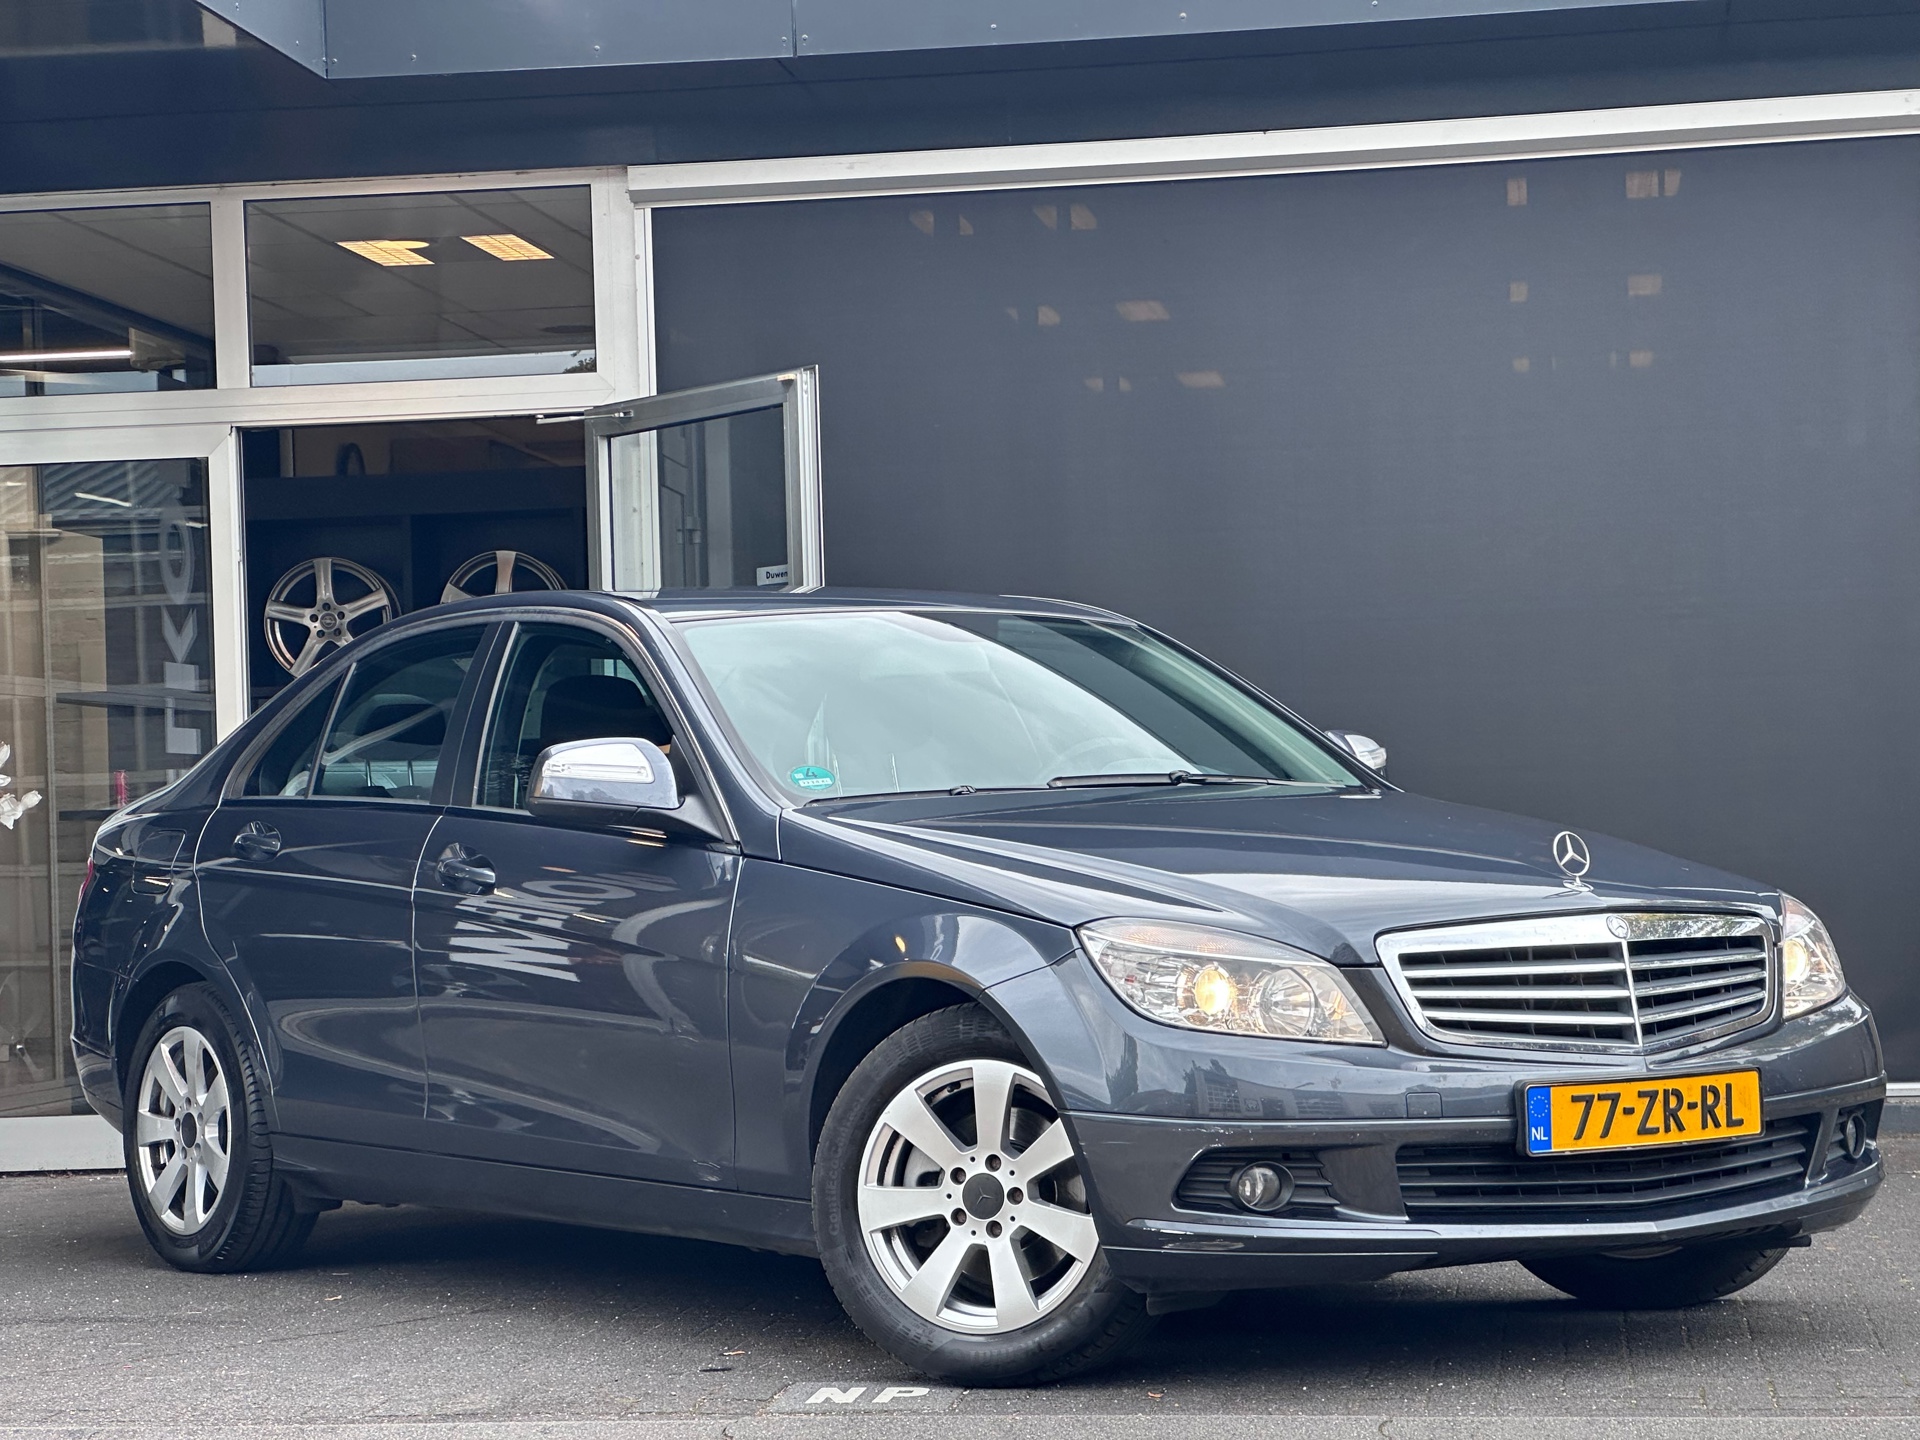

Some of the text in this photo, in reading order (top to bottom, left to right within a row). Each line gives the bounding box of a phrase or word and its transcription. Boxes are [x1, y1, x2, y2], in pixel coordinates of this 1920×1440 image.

[766, 571, 788, 579] Duwen
[805, 767, 818, 778] 4
[1571, 1083, 1744, 1140] 77-ZR-RL
[1531, 1126, 1549, 1141] NL
[804, 1387, 930, 1404] NP
